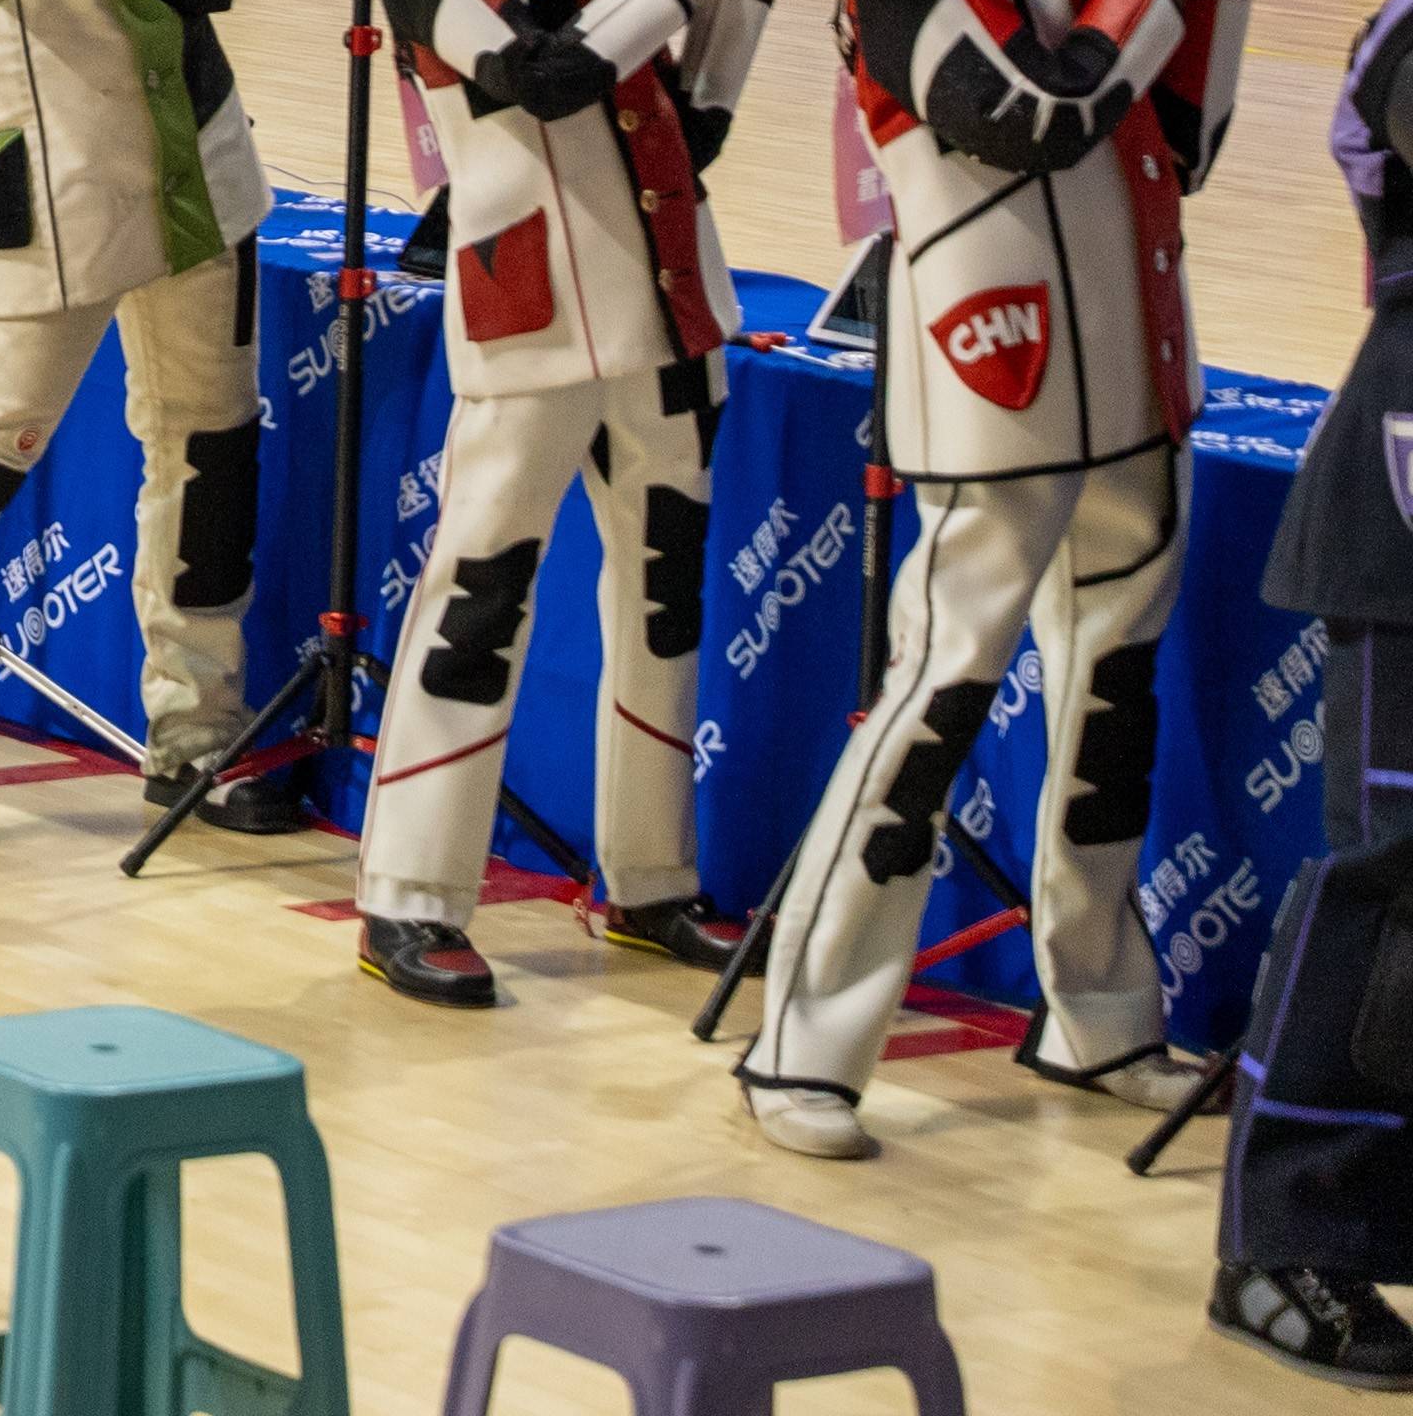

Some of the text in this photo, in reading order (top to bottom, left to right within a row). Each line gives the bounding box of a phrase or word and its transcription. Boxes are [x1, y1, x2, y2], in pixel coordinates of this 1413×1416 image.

[947, 301, 1042, 365] CHN
[0, 521, 71, 603] 速得尔
